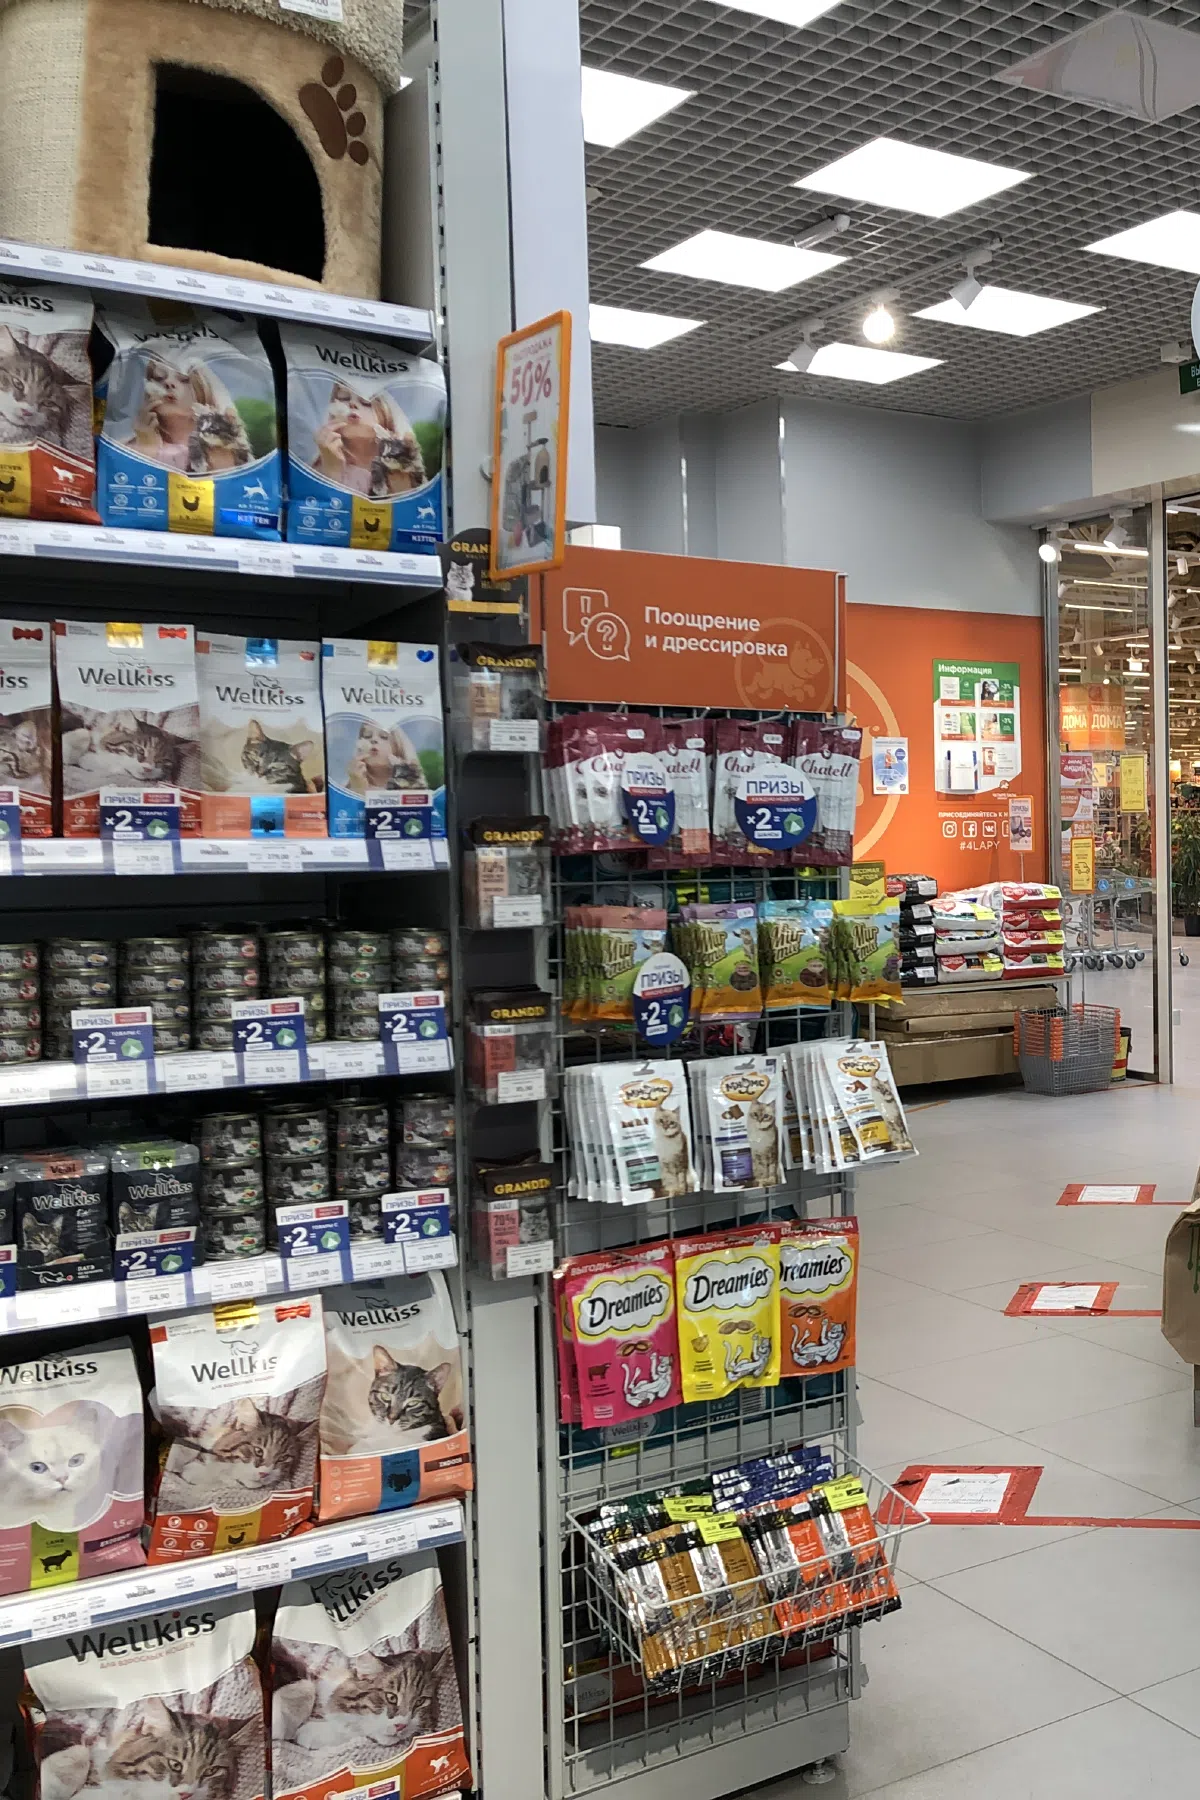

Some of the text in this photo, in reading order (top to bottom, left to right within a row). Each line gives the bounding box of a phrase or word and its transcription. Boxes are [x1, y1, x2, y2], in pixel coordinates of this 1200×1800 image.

[315, 344, 410, 374] Wellkiss
[510, 359, 553, 407] 50%
[450, 541, 491, 554] GRAN
[644, 606, 761, 632] Поощрение
[645, 634, 788, 658] и дрессировка
[476, 655, 537, 669] GRANDIN
[938, 664, 993, 675] Информация
[78, 666, 175, 688] Wellkiss
[215, 685, 305, 706] Wellkiss
[341, 686, 425, 707] Wellkiss
[1091, 715, 1123, 730] ДОМА
[626, 770, 666, 787] ПРИЗЫ
[746, 780, 805, 795] ПРИЗЫ
[938, 810, 998, 818] ПРИСОЕДИНЯЙТЕСЬ
[483, 830, 545, 842] GRANDIN
[959, 841, 1000, 851] #4LAPY
[640, 969, 684, 988] ПРИЗЫ
[235, 1008, 269, 1017] ПРИЗЫ
[382, 1000, 412, 1009] ПРИЗЫ
[490, 1005, 545, 1020] GRANDIN
[76, 1017, 113, 1027] ПРИЗЫ
[50, 1163, 77, 1174] Veal
[128, 1182, 193, 1200] Wellkiss
[494, 1178, 551, 1196] GRANDIN
[32, 1192, 101, 1211] Wellkiss
[385, 1198, 416, 1209] ПРИЗЫ
[280, 1212, 313, 1223] ПРИЗЫ
[120, 1237, 158, 1247] ПРИЗЫ
[693, 1266, 769, 1305] Dreamies
[588, 1283, 663, 1328] Dreamies
[337, 1302, 421, 1328] Wellkiss
[0, 1359, 98, 1387] Wellkiss
[314, 1560, 404, 1625] llkiss
[66, 1611, 216, 1664] Wellkiss
